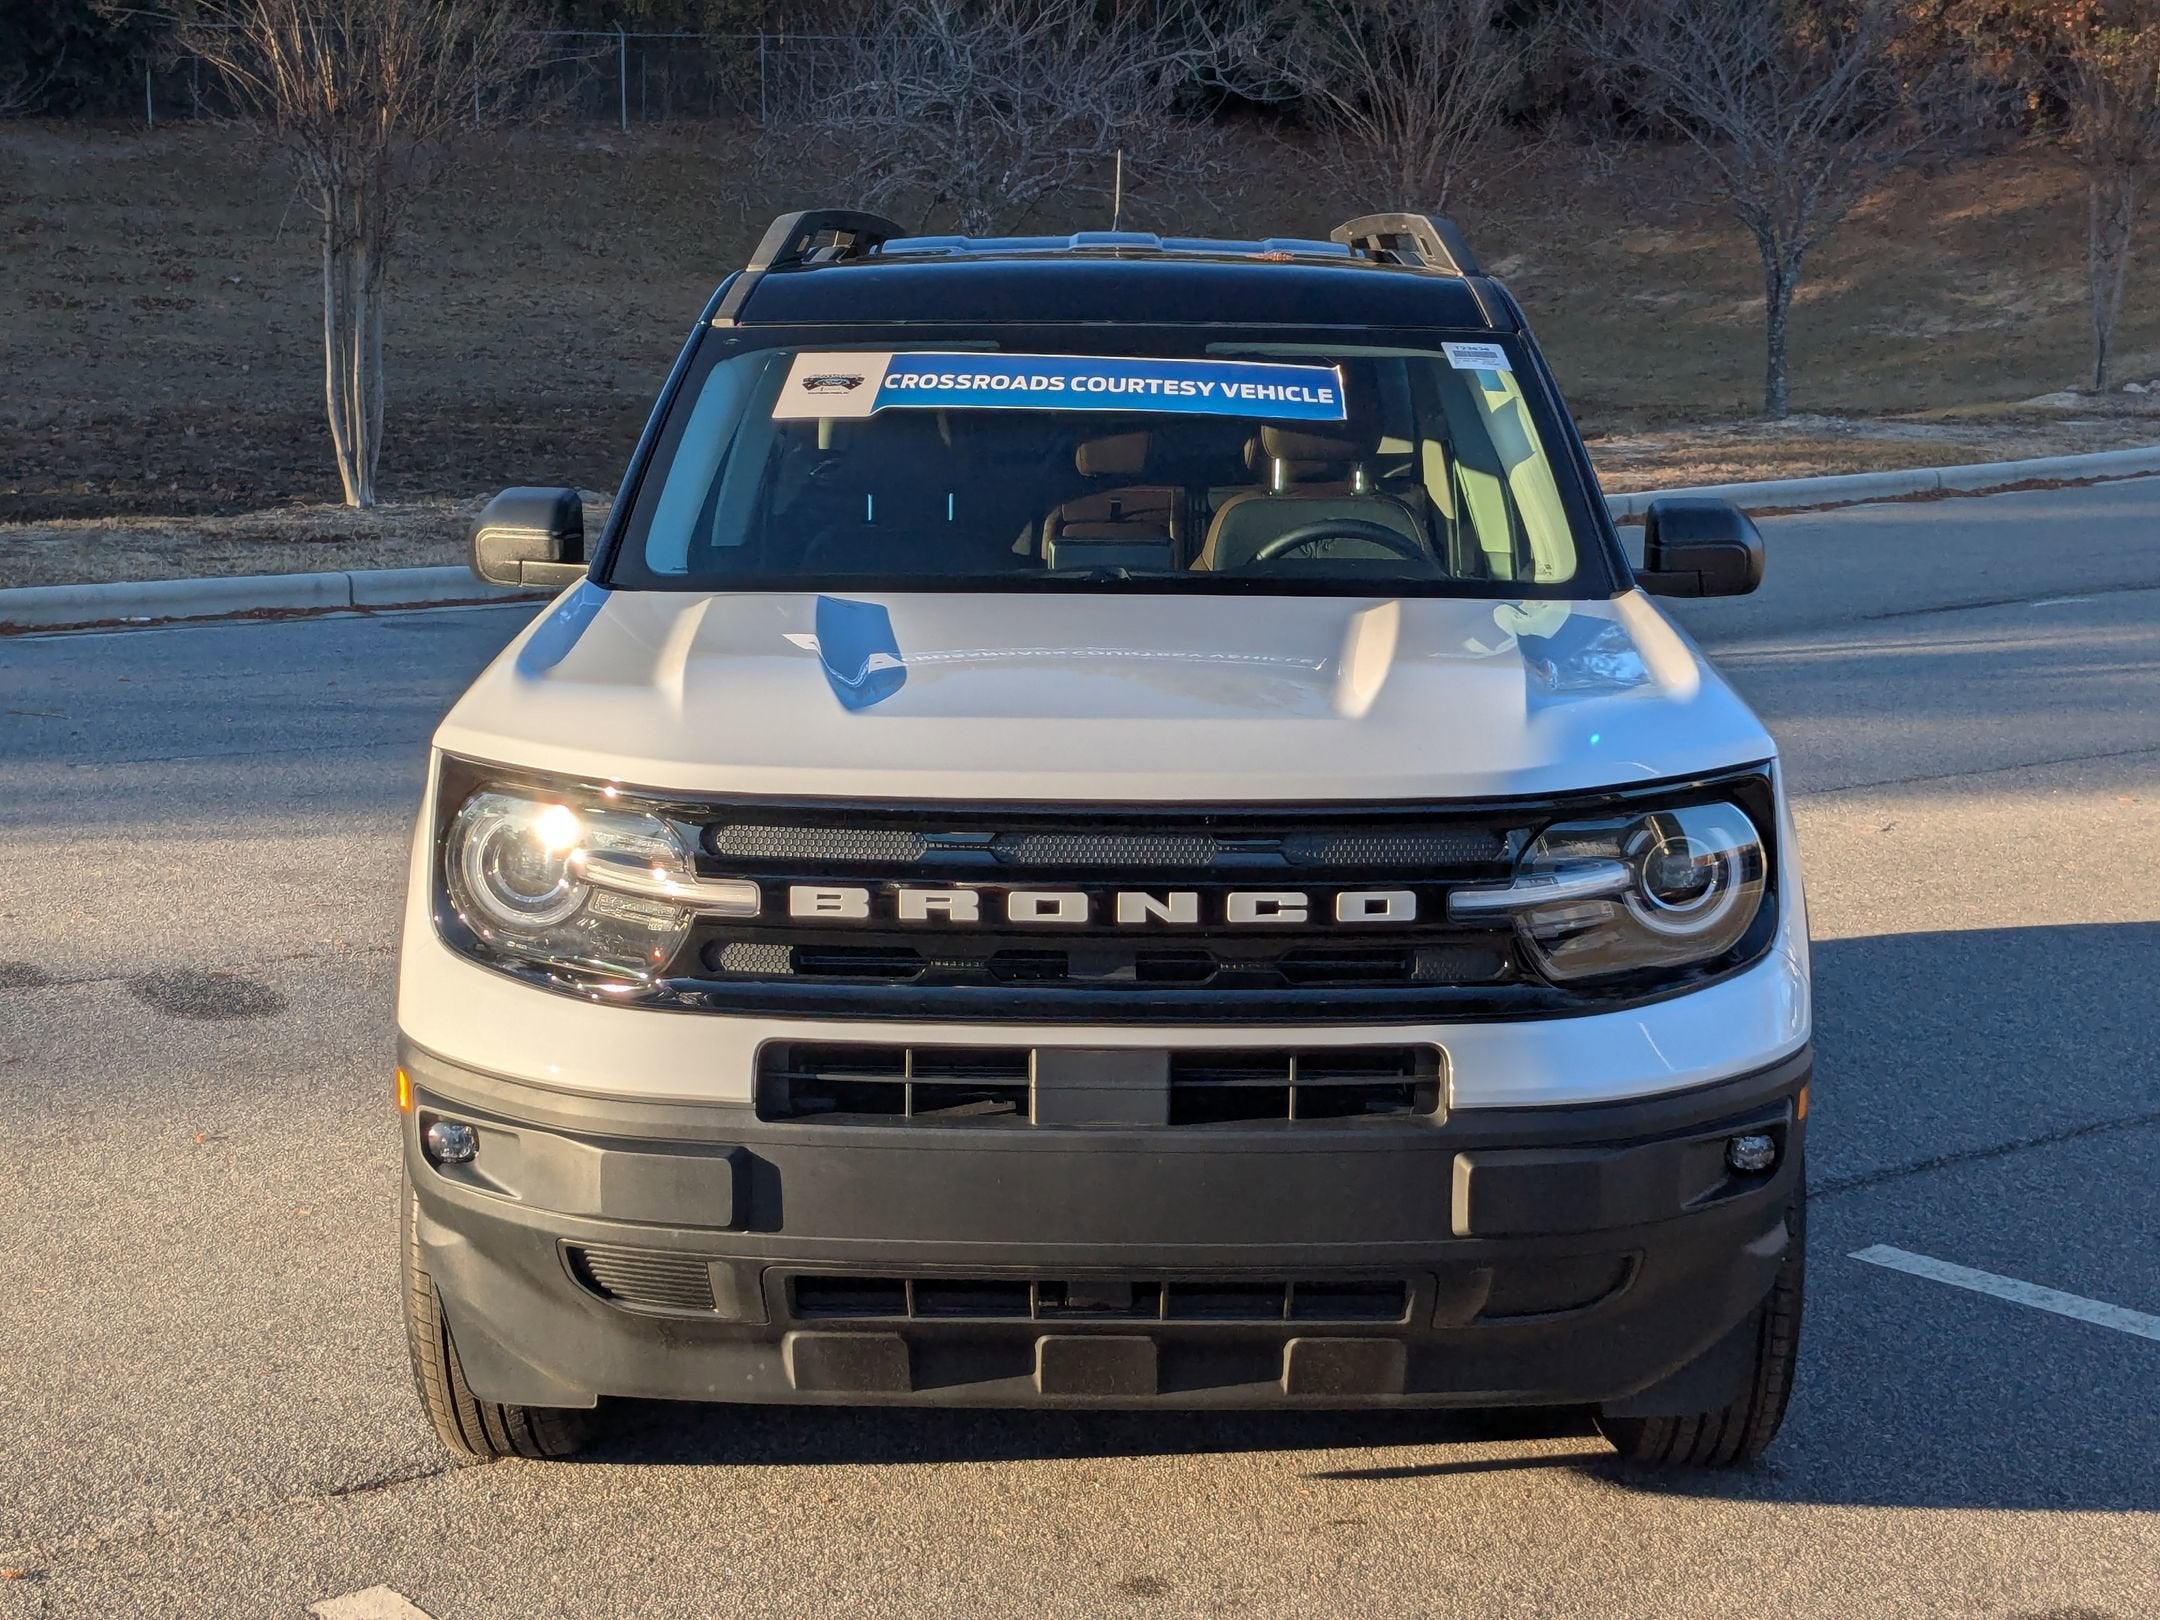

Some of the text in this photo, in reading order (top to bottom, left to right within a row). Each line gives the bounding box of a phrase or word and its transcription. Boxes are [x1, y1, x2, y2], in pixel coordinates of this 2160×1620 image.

[884, 373, 1335, 404] CROSSROADS COURTESY VEHICLE
[789, 886, 1417, 923] BRONCO
